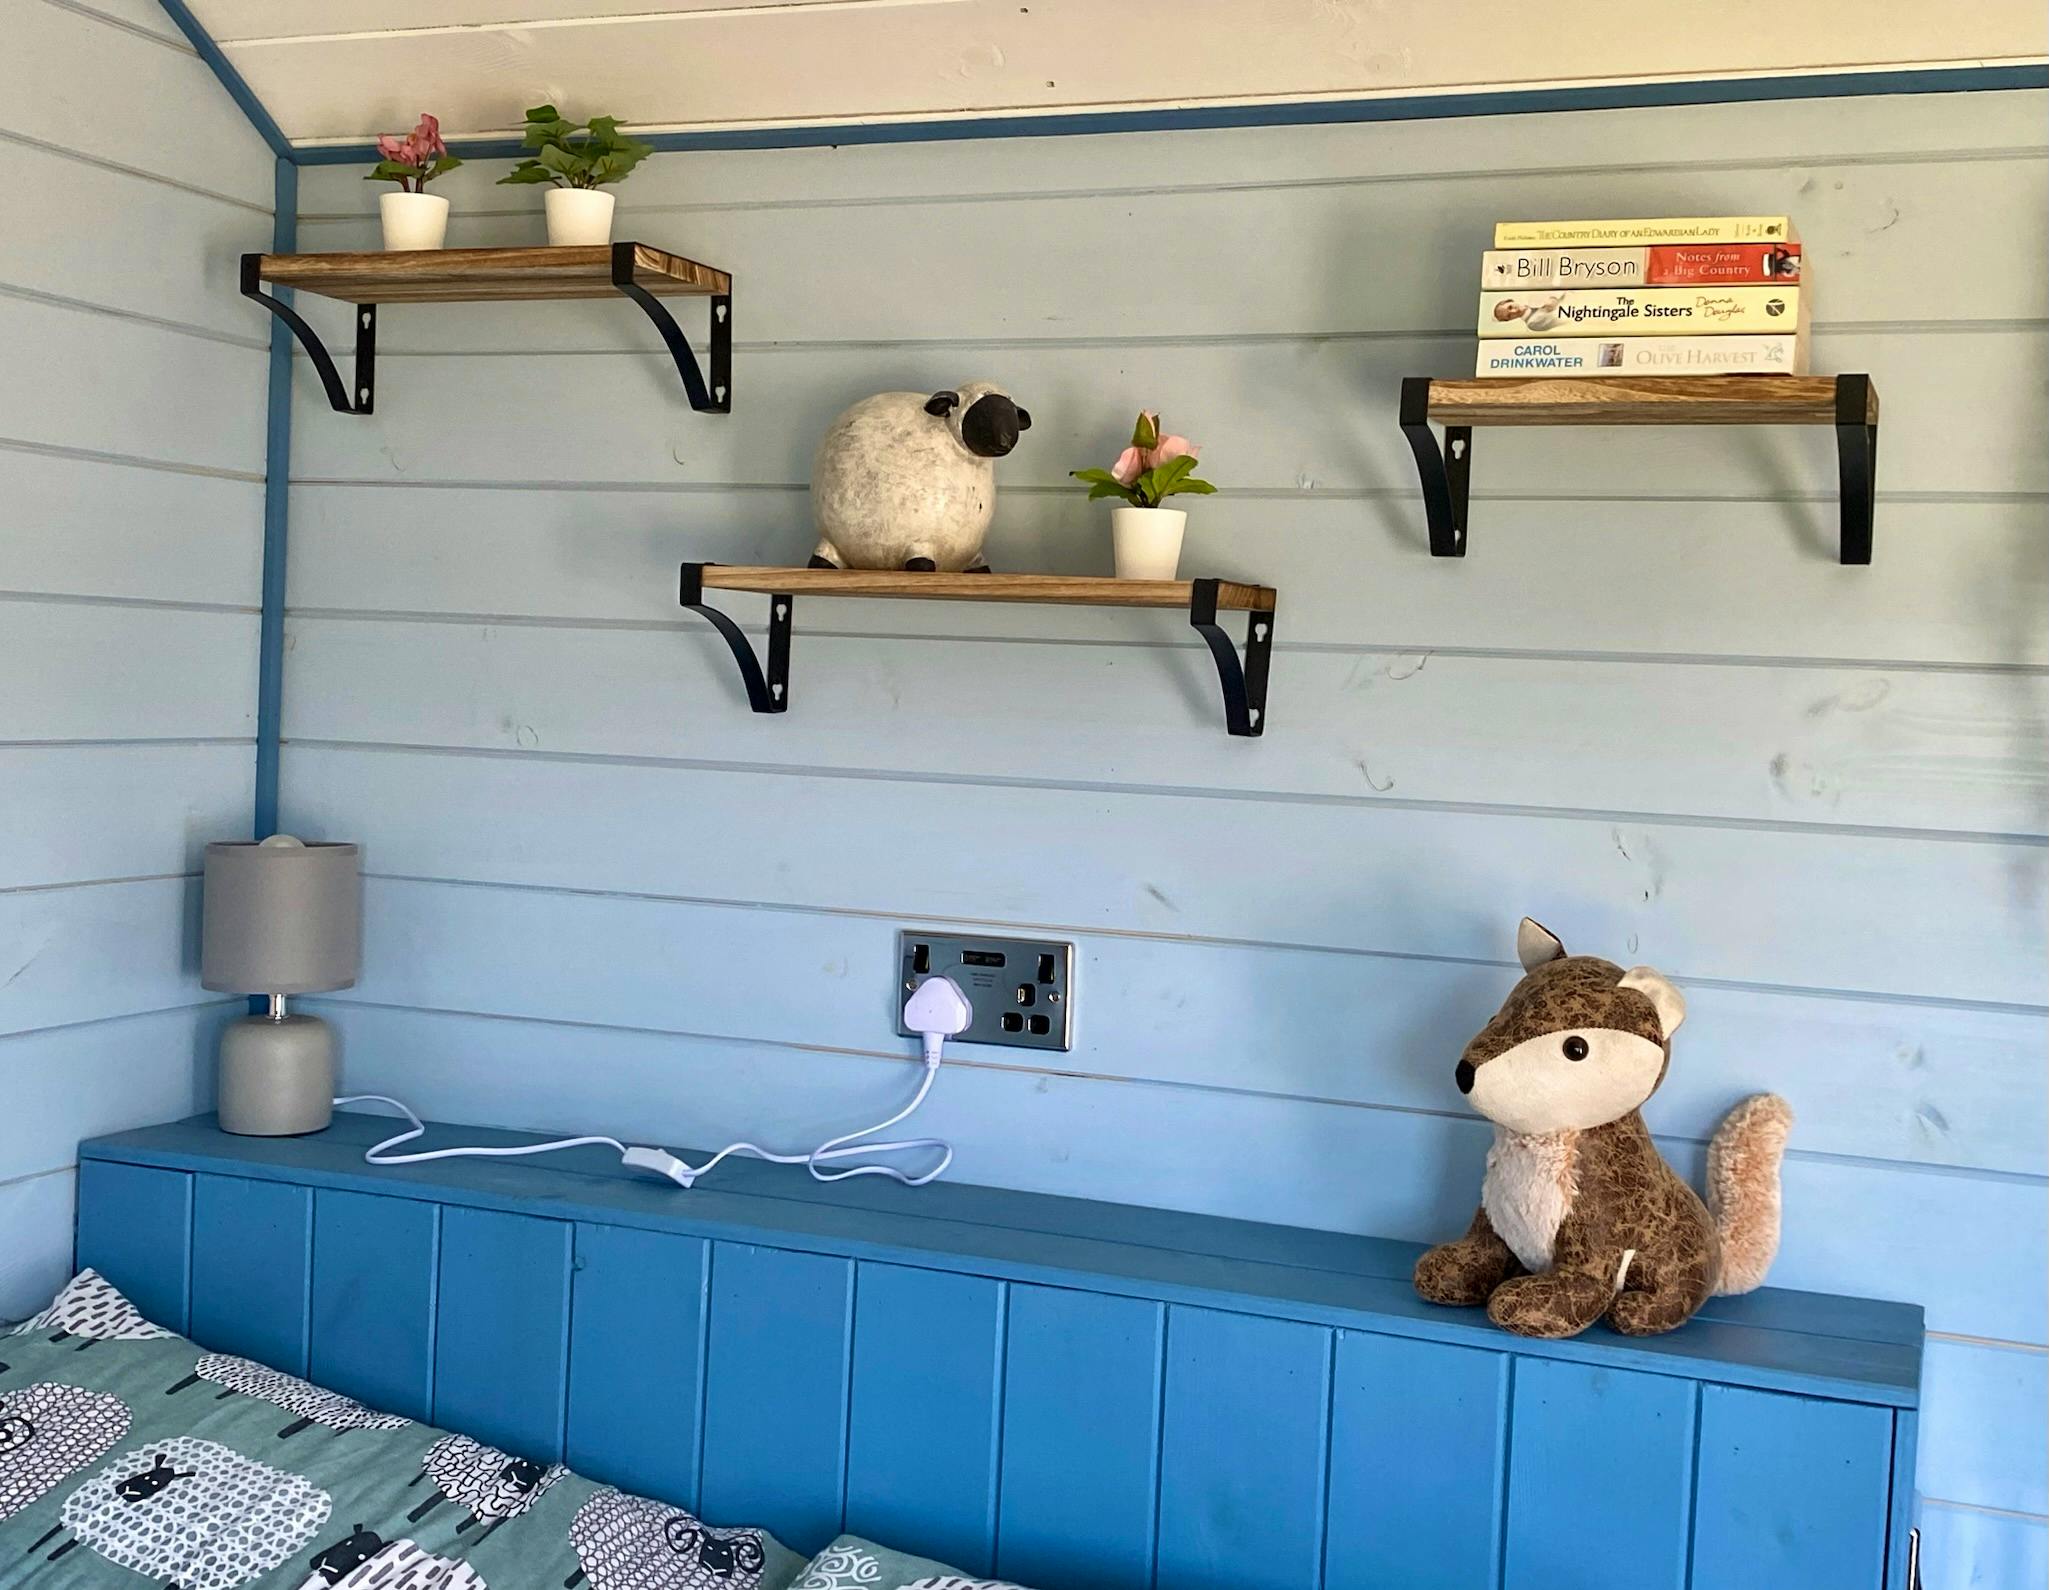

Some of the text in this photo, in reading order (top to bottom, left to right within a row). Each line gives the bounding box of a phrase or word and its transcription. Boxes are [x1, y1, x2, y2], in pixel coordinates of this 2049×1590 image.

[1552, 229, 1591, 240] COUNTRY
[1591, 228, 1617, 239] DIARY
[1643, 227, 1695, 237] EDWARDIAN
[1695, 225, 1720, 236] LADY
[1675, 250, 1741, 264] Notes from
[1517, 257, 1550, 277] Bill
[1559, 256, 1636, 278] Bryson
[1674, 265, 1695, 277] Big
[1699, 263, 1751, 276] Country
[1616, 296, 1635, 306] The
[1695, 296, 1734, 308] Donna
[1558, 303, 1693, 322] Nightingale Sisters
[1704, 303, 1746, 322] Douglas
[1514, 345, 1561, 356] CAROL
[1636, 348, 1758, 365] OLIVE HARVEST
[1490, 357, 1583, 369] DRINKWATER
